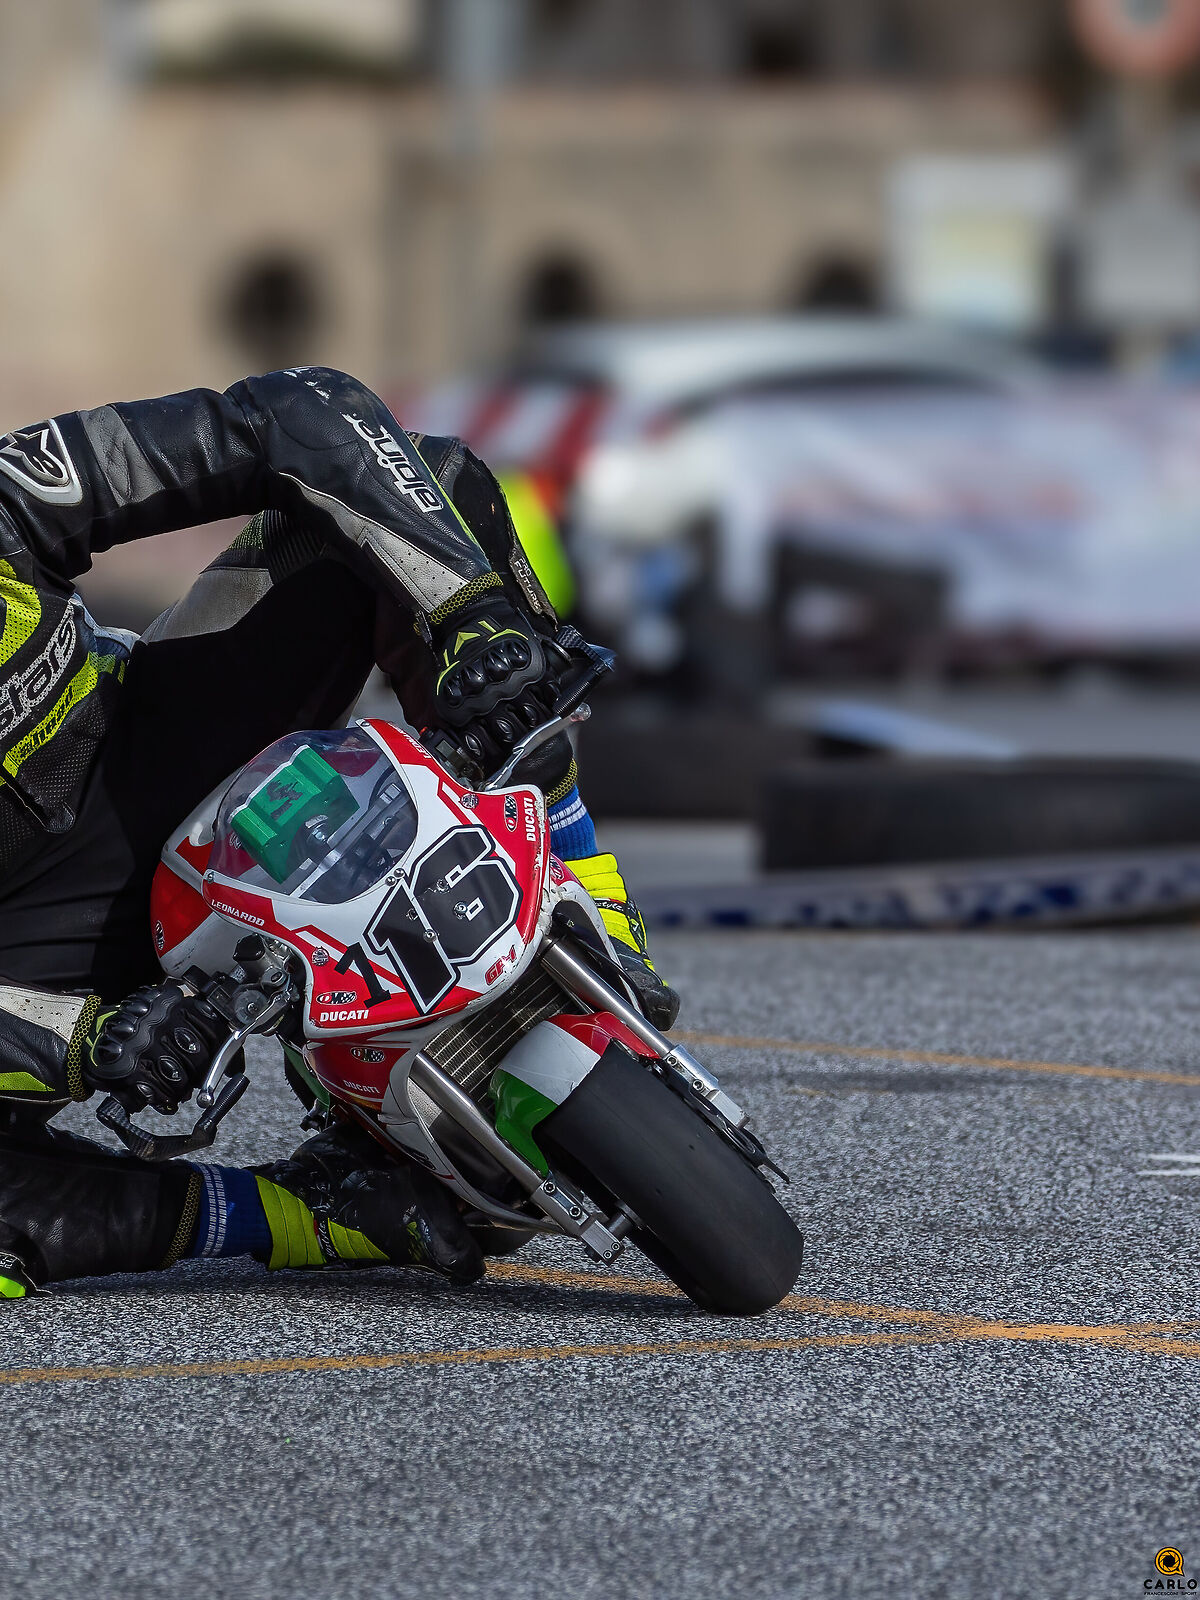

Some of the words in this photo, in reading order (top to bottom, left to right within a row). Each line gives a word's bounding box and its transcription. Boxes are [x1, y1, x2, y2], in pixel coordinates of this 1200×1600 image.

[523, 797, 537, 842] DUCATI
[211, 899, 265, 927] LEONARDO
[319, 1009, 370, 1022] DUCATI
[343, 1079, 381, 1094] DUCATI
